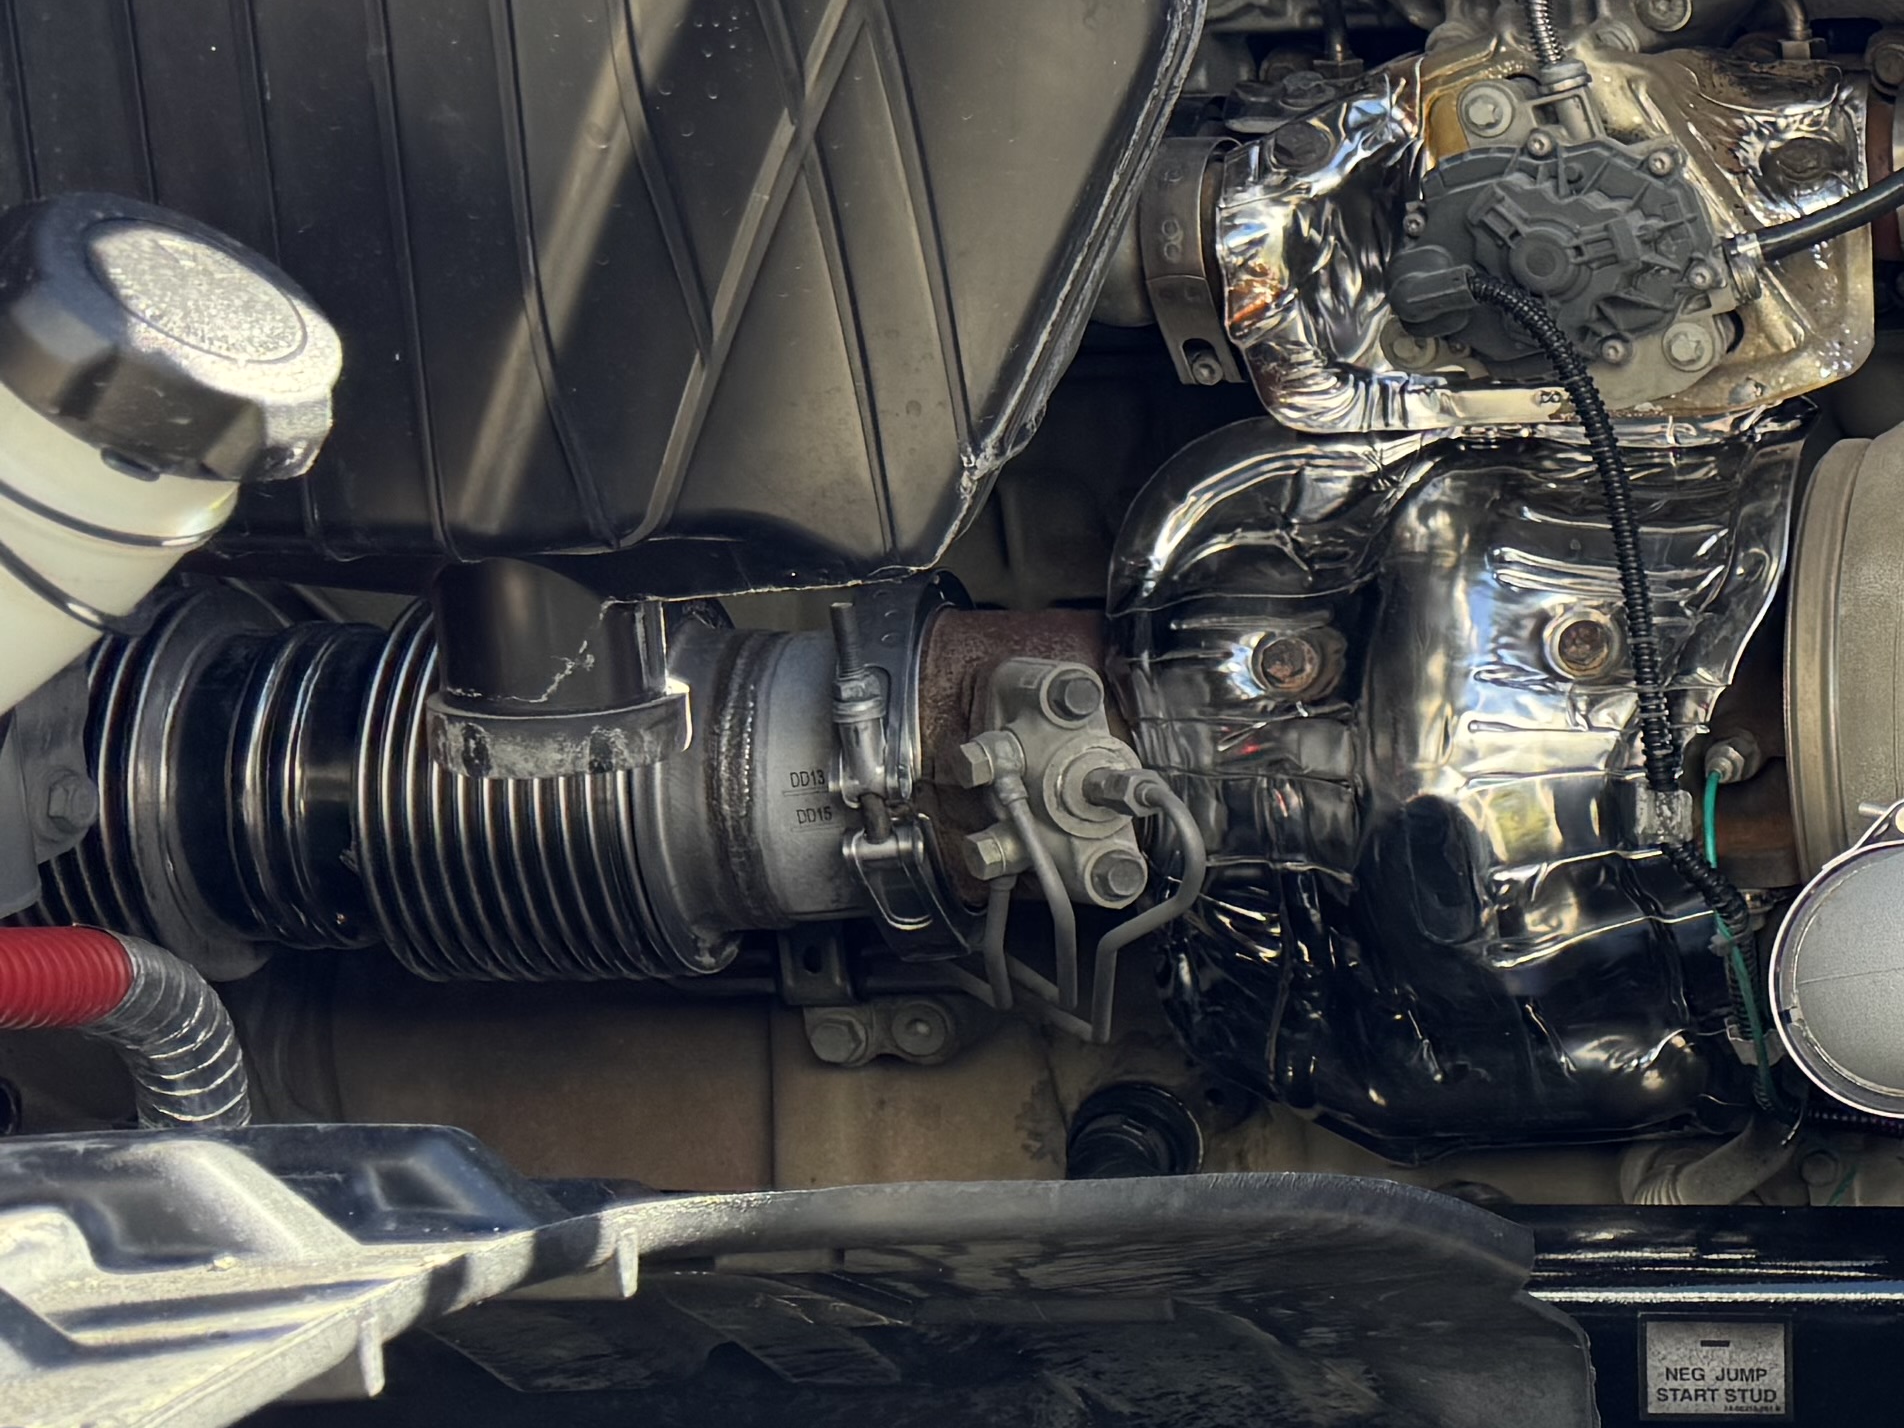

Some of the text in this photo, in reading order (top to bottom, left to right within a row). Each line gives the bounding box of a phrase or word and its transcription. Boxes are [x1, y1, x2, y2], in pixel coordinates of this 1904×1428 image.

[790, 769, 825, 788] DD13
[1665, 1367, 1767, 1382] NEG JUMP
[1657, 1388, 1777, 1403] START STUD
